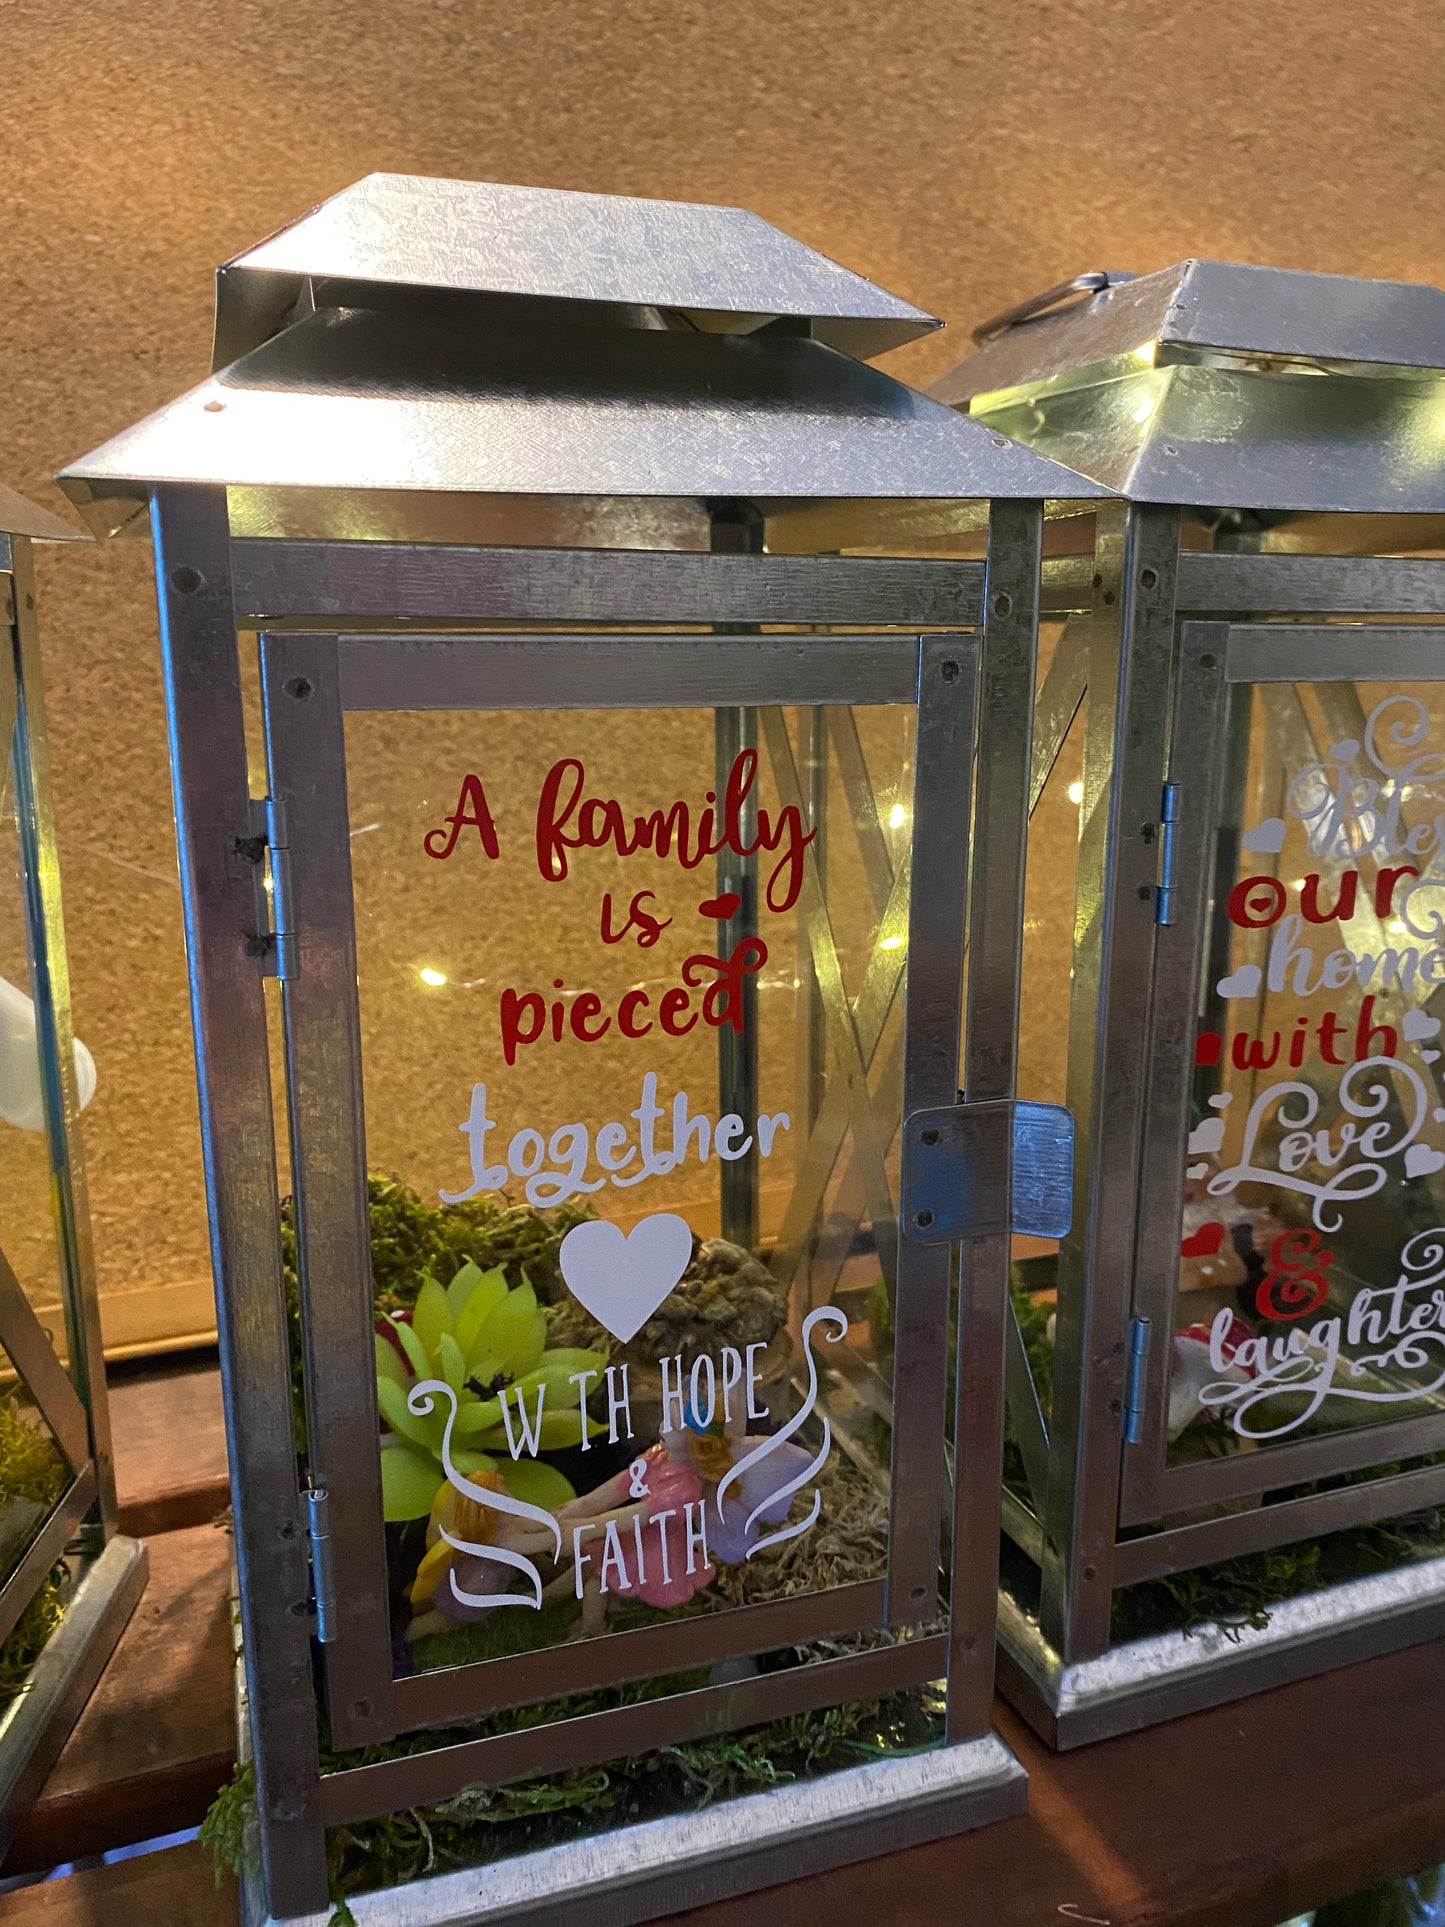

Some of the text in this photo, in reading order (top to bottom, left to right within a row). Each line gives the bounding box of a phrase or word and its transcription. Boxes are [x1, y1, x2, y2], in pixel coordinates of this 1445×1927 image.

[424, 748, 818, 913] A family
[600, 890, 673, 948] is
[1227, 865, 1420, 929] our
[500, 936, 768, 1067] pieced
[1231, 994, 1399, 1071] with
[438, 1071, 790, 1209] together
[1206, 1055, 1428, 1233] Love
[1255, 1227, 1335, 1321] &
[661, 1341, 770, 1434] HOPE
[628, 1458, 651, 1499] &
[572, 1499, 714, 1600] FAITH
